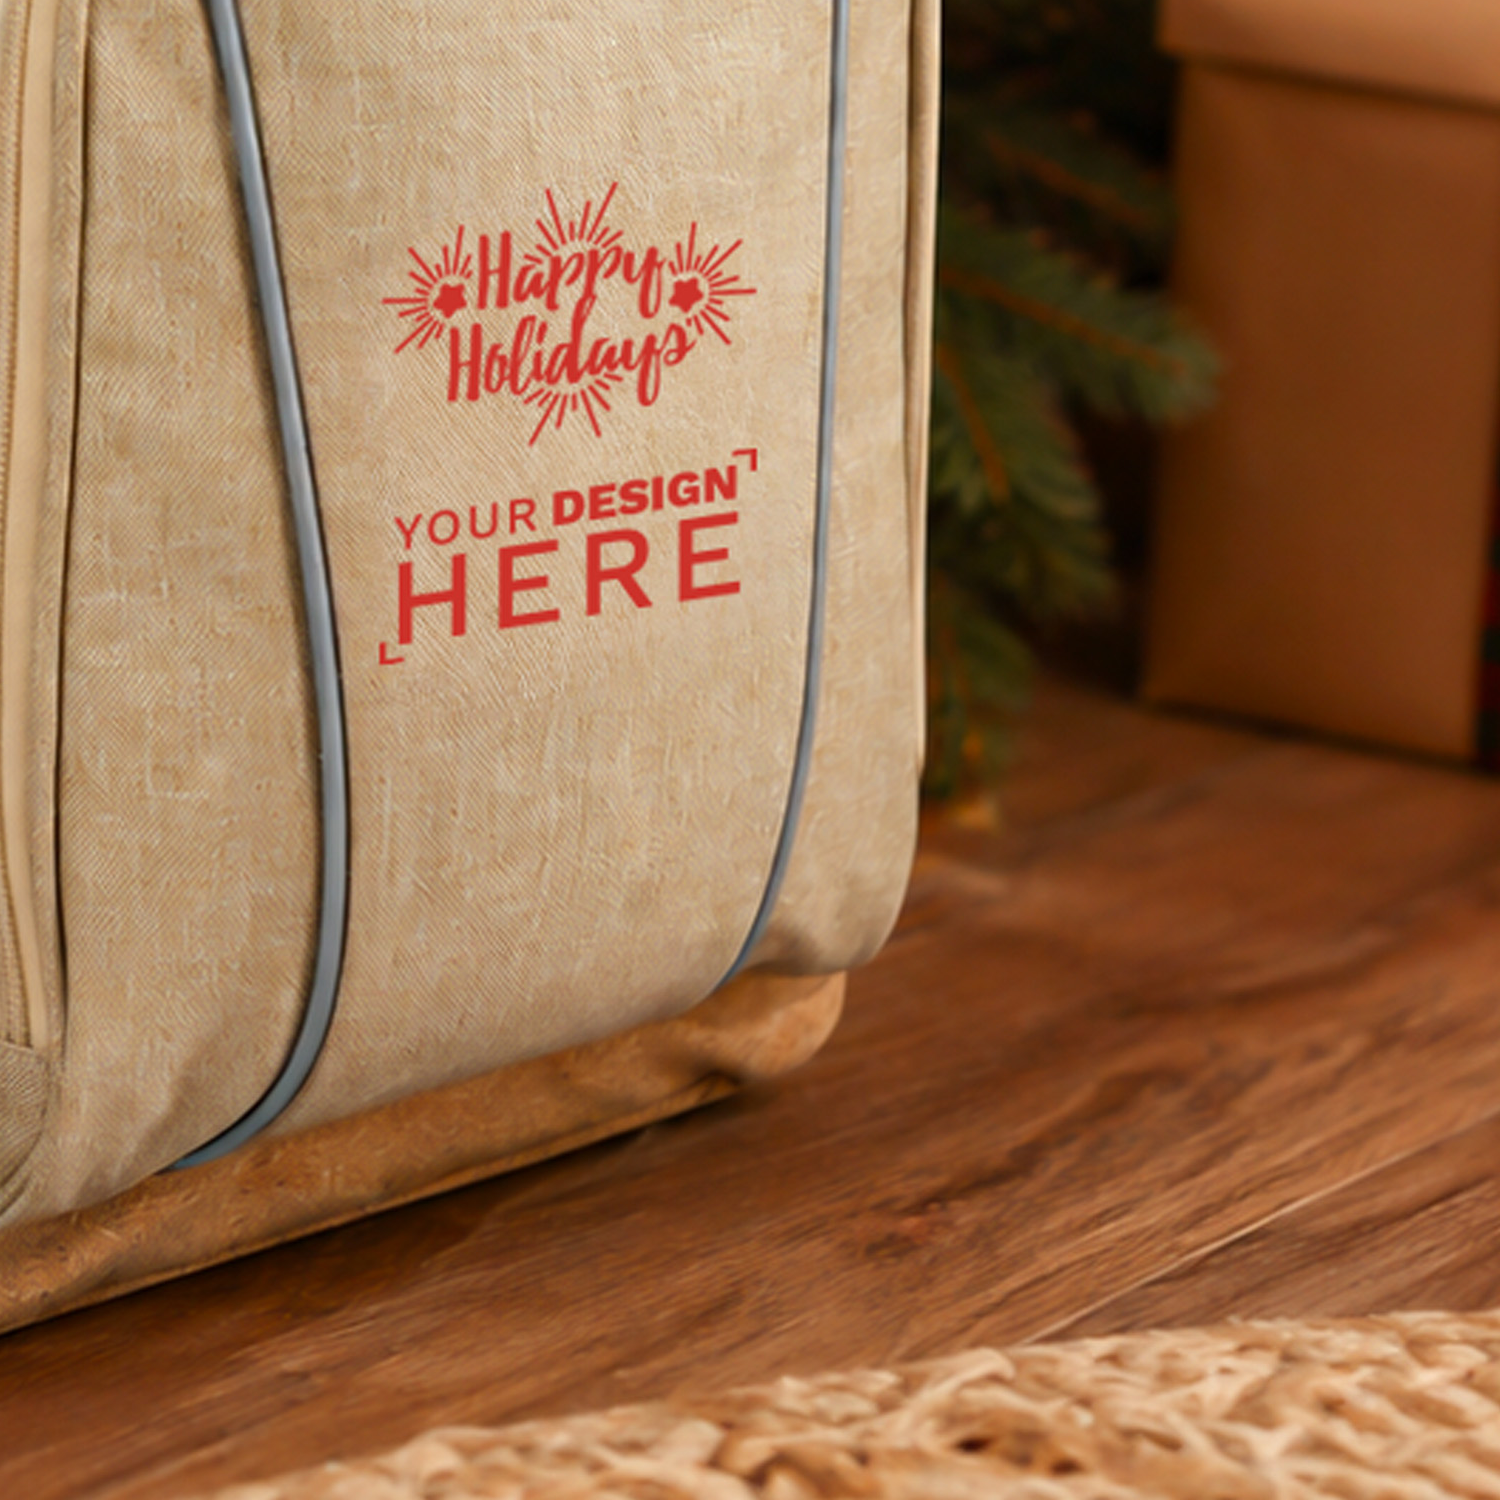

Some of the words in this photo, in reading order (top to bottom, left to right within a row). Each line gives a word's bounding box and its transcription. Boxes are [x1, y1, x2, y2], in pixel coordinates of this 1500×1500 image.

[478, 230, 665, 319] Happy
[447, 296, 697, 407] Holidays
[395, 498, 537, 550] YOUR
[552, 465, 738, 526] DESIGN
[398, 511, 741, 645] HERE
